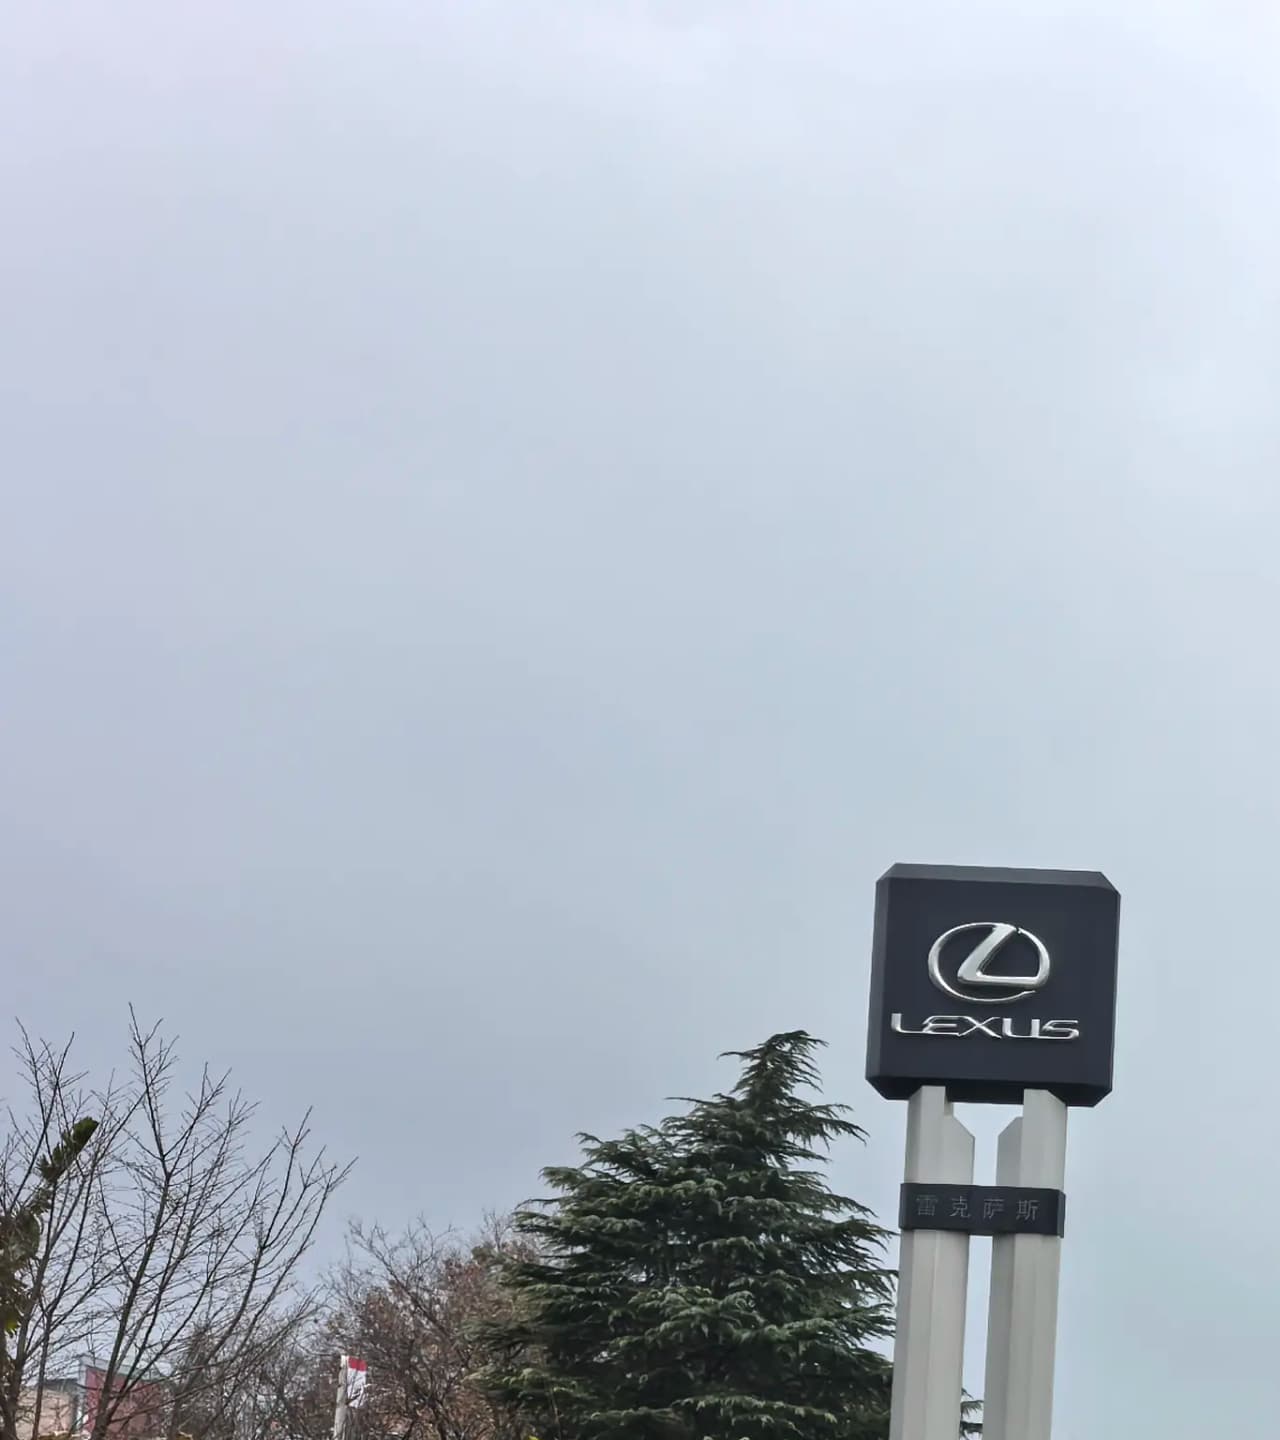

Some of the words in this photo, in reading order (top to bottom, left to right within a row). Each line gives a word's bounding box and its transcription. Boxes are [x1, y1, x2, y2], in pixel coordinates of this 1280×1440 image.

[891, 1012, 1080, 1040] LEXUS
[915, 1193, 1041, 1222] 雷克萨斯
